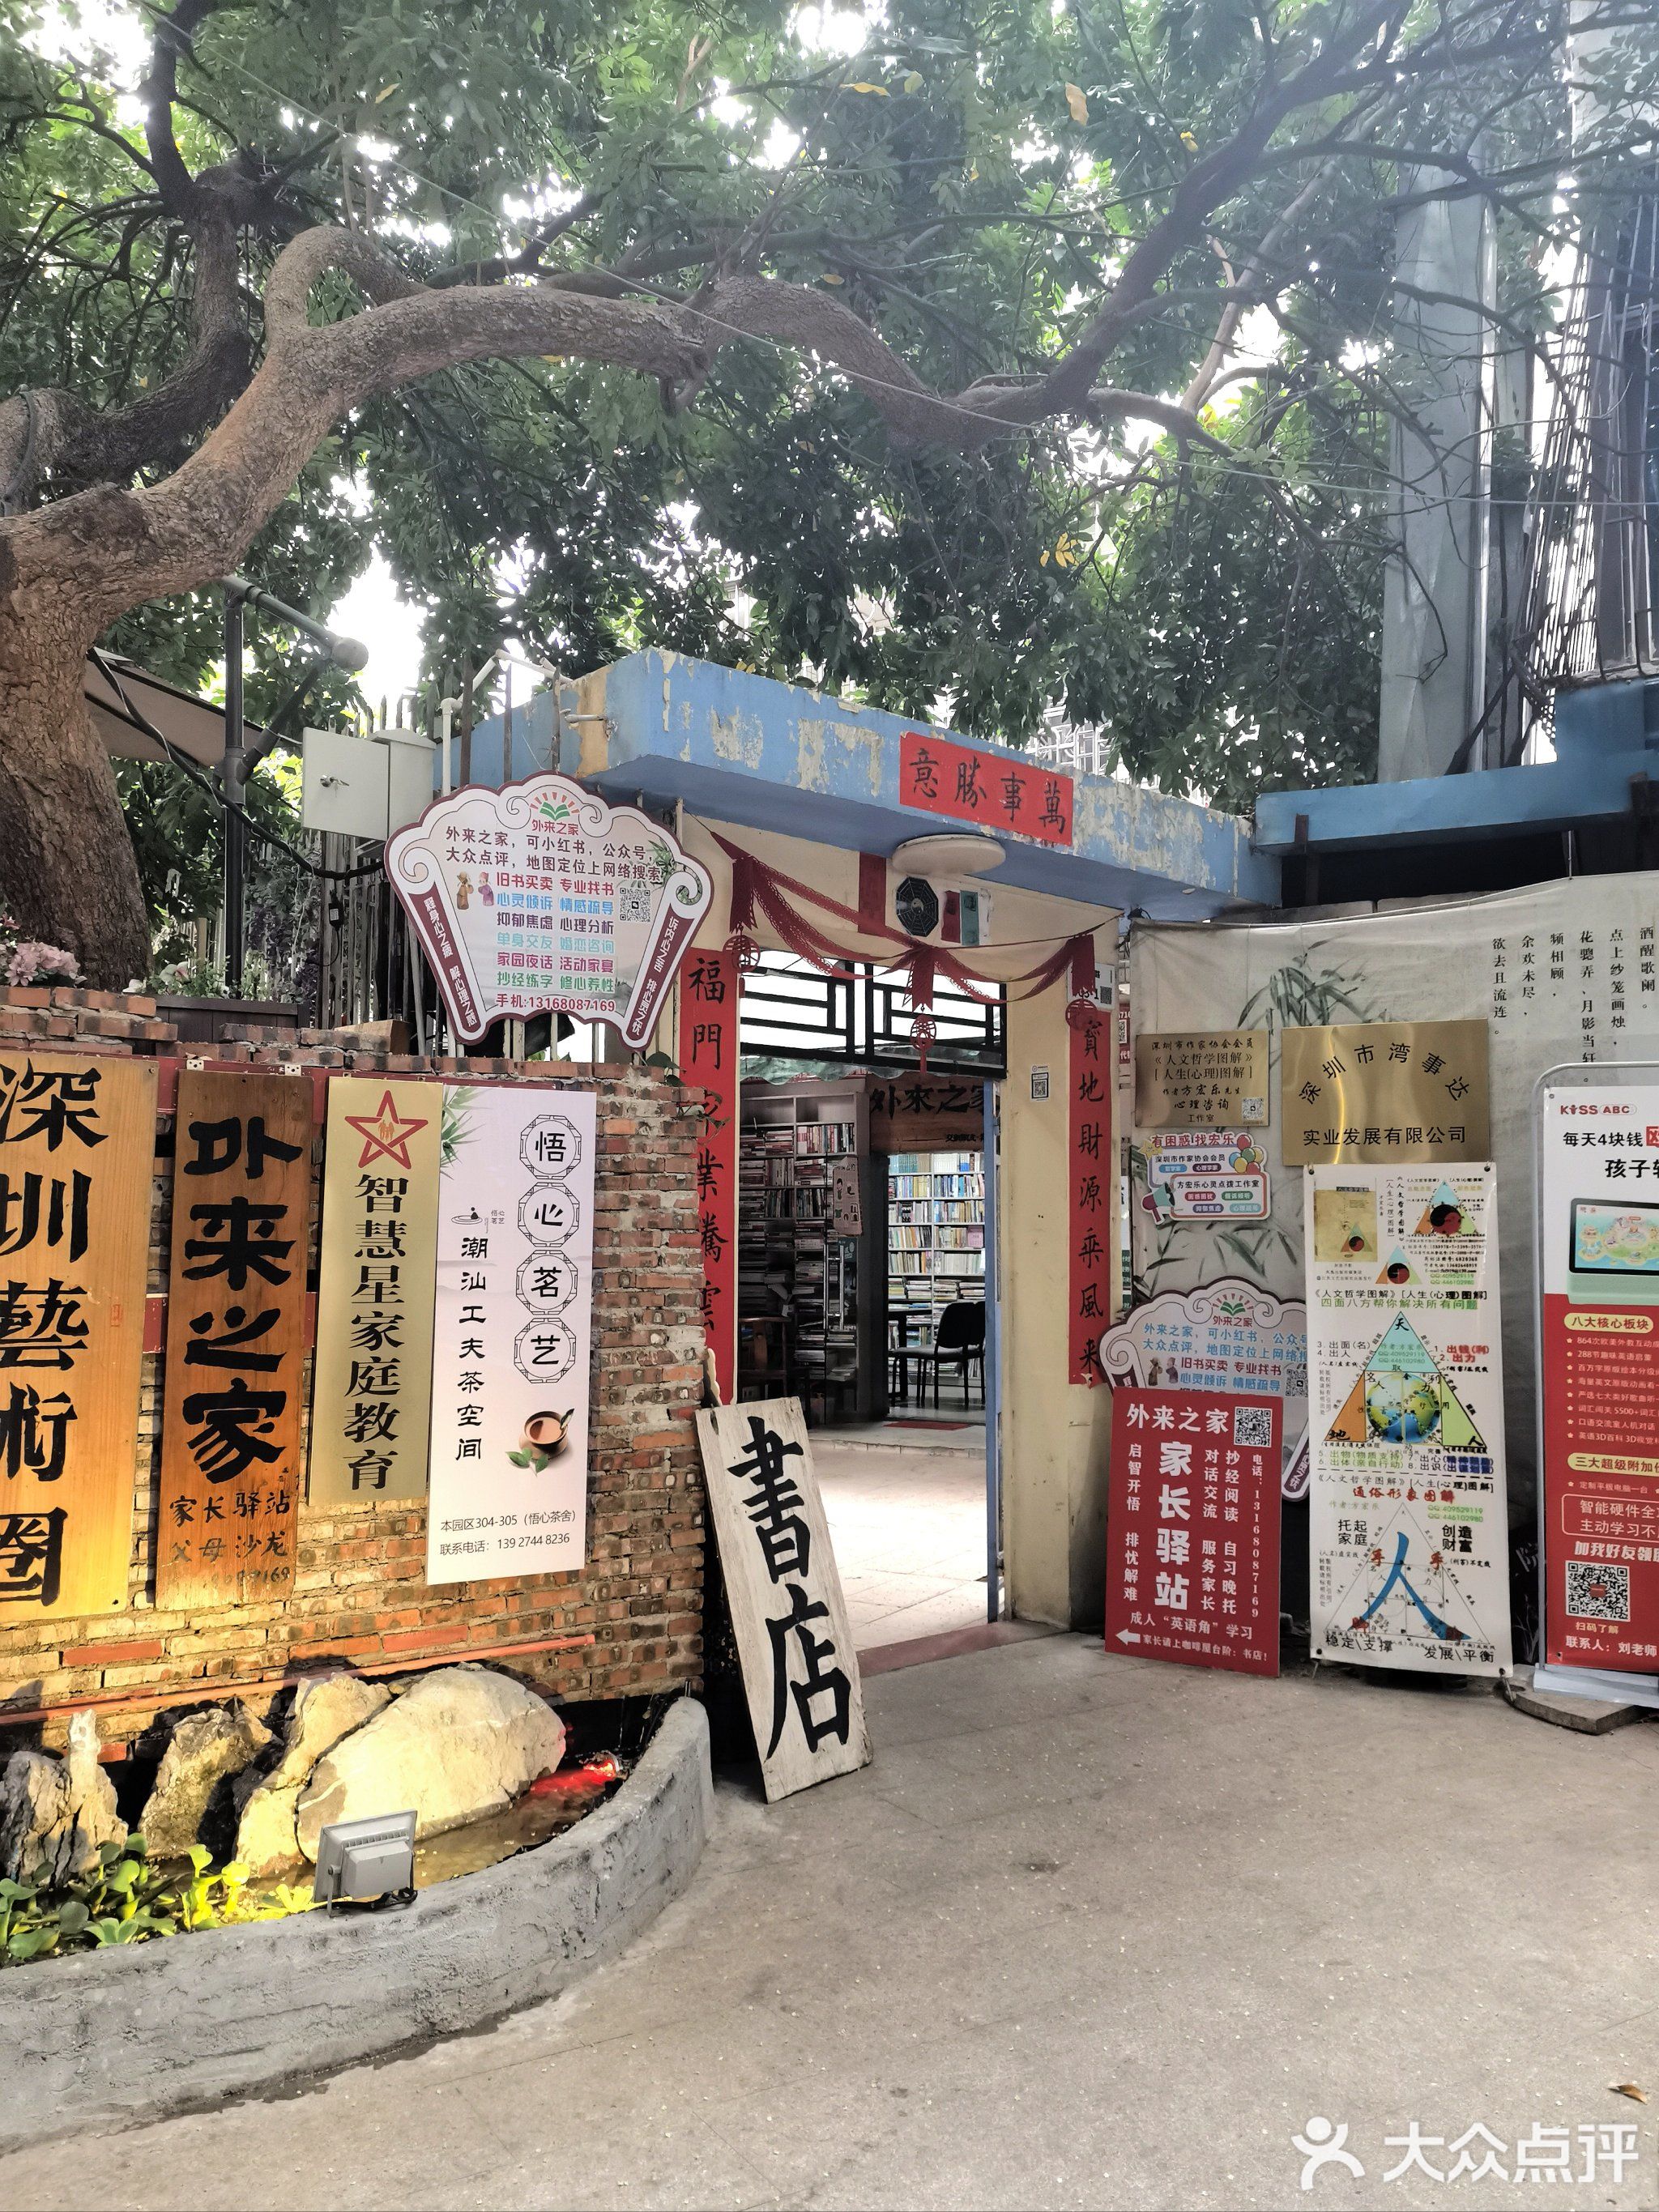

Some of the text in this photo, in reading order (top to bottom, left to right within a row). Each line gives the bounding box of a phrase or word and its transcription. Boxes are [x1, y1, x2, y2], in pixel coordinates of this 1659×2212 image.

[531, 819, 579, 835] 外来之家
[496, 872, 615, 897] 旧书买卖 专业找书
[496, 892, 615, 915] 心灵倾诉 情感疏导
[496, 911, 615, 935] 抑郁焦虑 心理分析
[496, 931, 615, 954] 单身交友 婚恋咨询
[496, 952, 615, 974] 家园夜话 活动家宴
[496, 972, 615, 992] 抄经练字 修心养性
[1151, 1038, 1253, 1051] 深圳市作家协会会员
[1299, 1042, 1470, 1105] 深圳市湾事达
[1174, 1098, 1230, 1110] 心理咨询
[1603, 1106, 1630, 1114] ABC
[1187, 1115, 1216, 1123] 工作室
[1151, 1133, 1235, 1148] 有困惑 找宏乐
[1303, 1126, 1467, 1147] 实业发展有限公司
[1155, 1154, 1226, 1163] 深圳市作家协会会员
[530, 1130, 569, 1366] 悟心茗艺
[181, 1116, 303, 1485] 外来之家
[1213, 1315, 1253, 1328] 外来之家
[1394, 1318, 1410, 1331] 天
[1572, 1316, 1649, 1331] 八大核心板块
[343, 1173, 410, 1492] 智慧星家庭教育
[454, 1236, 489, 1462] 潮汕工夫茶空间
[1180, 1357, 1282, 1376] 旧书买卖 专业找书
[1179, 1373, 1227, 1387] 心灵倾诉
[1233, 1377, 1282, 1392] 情感疏导
[1127, 1404, 1230, 1435] 外来之家
[1614, 1407, 1659, 1417] 5500+词汇
[169, 1490, 291, 1528] 家长驿站
[1580, 1499, 1659, 1519] 智能硬件全
[1124, 1443, 1142, 1603] 启智开悟 排忧解难
[1154, 1441, 1193, 1612] 家长驿站
[1201, 1450, 1219, 1612] 对话交流 服务家长
[1222, 1450, 1240, 1616] 抄经阅读 自习晚托
[1337, 1519, 1367, 1532] 托起
[1442, 1524, 1473, 1539] 创造
[1580, 1519, 1659, 1539] 主动学习不
[172, 1530, 288, 1563] 父母沙龙
[497, 1538, 516, 1549] 139
[518, 1536, 543, 1548] 2744
[545, 1532, 570, 1545] 8236
[1337, 1532, 1368, 1546] 家庭
[1442, 1538, 1473, 1554] 财富
[727, 1416, 851, 1764] 書店
[1575, 1622, 1620, 1634] 扫码了解
